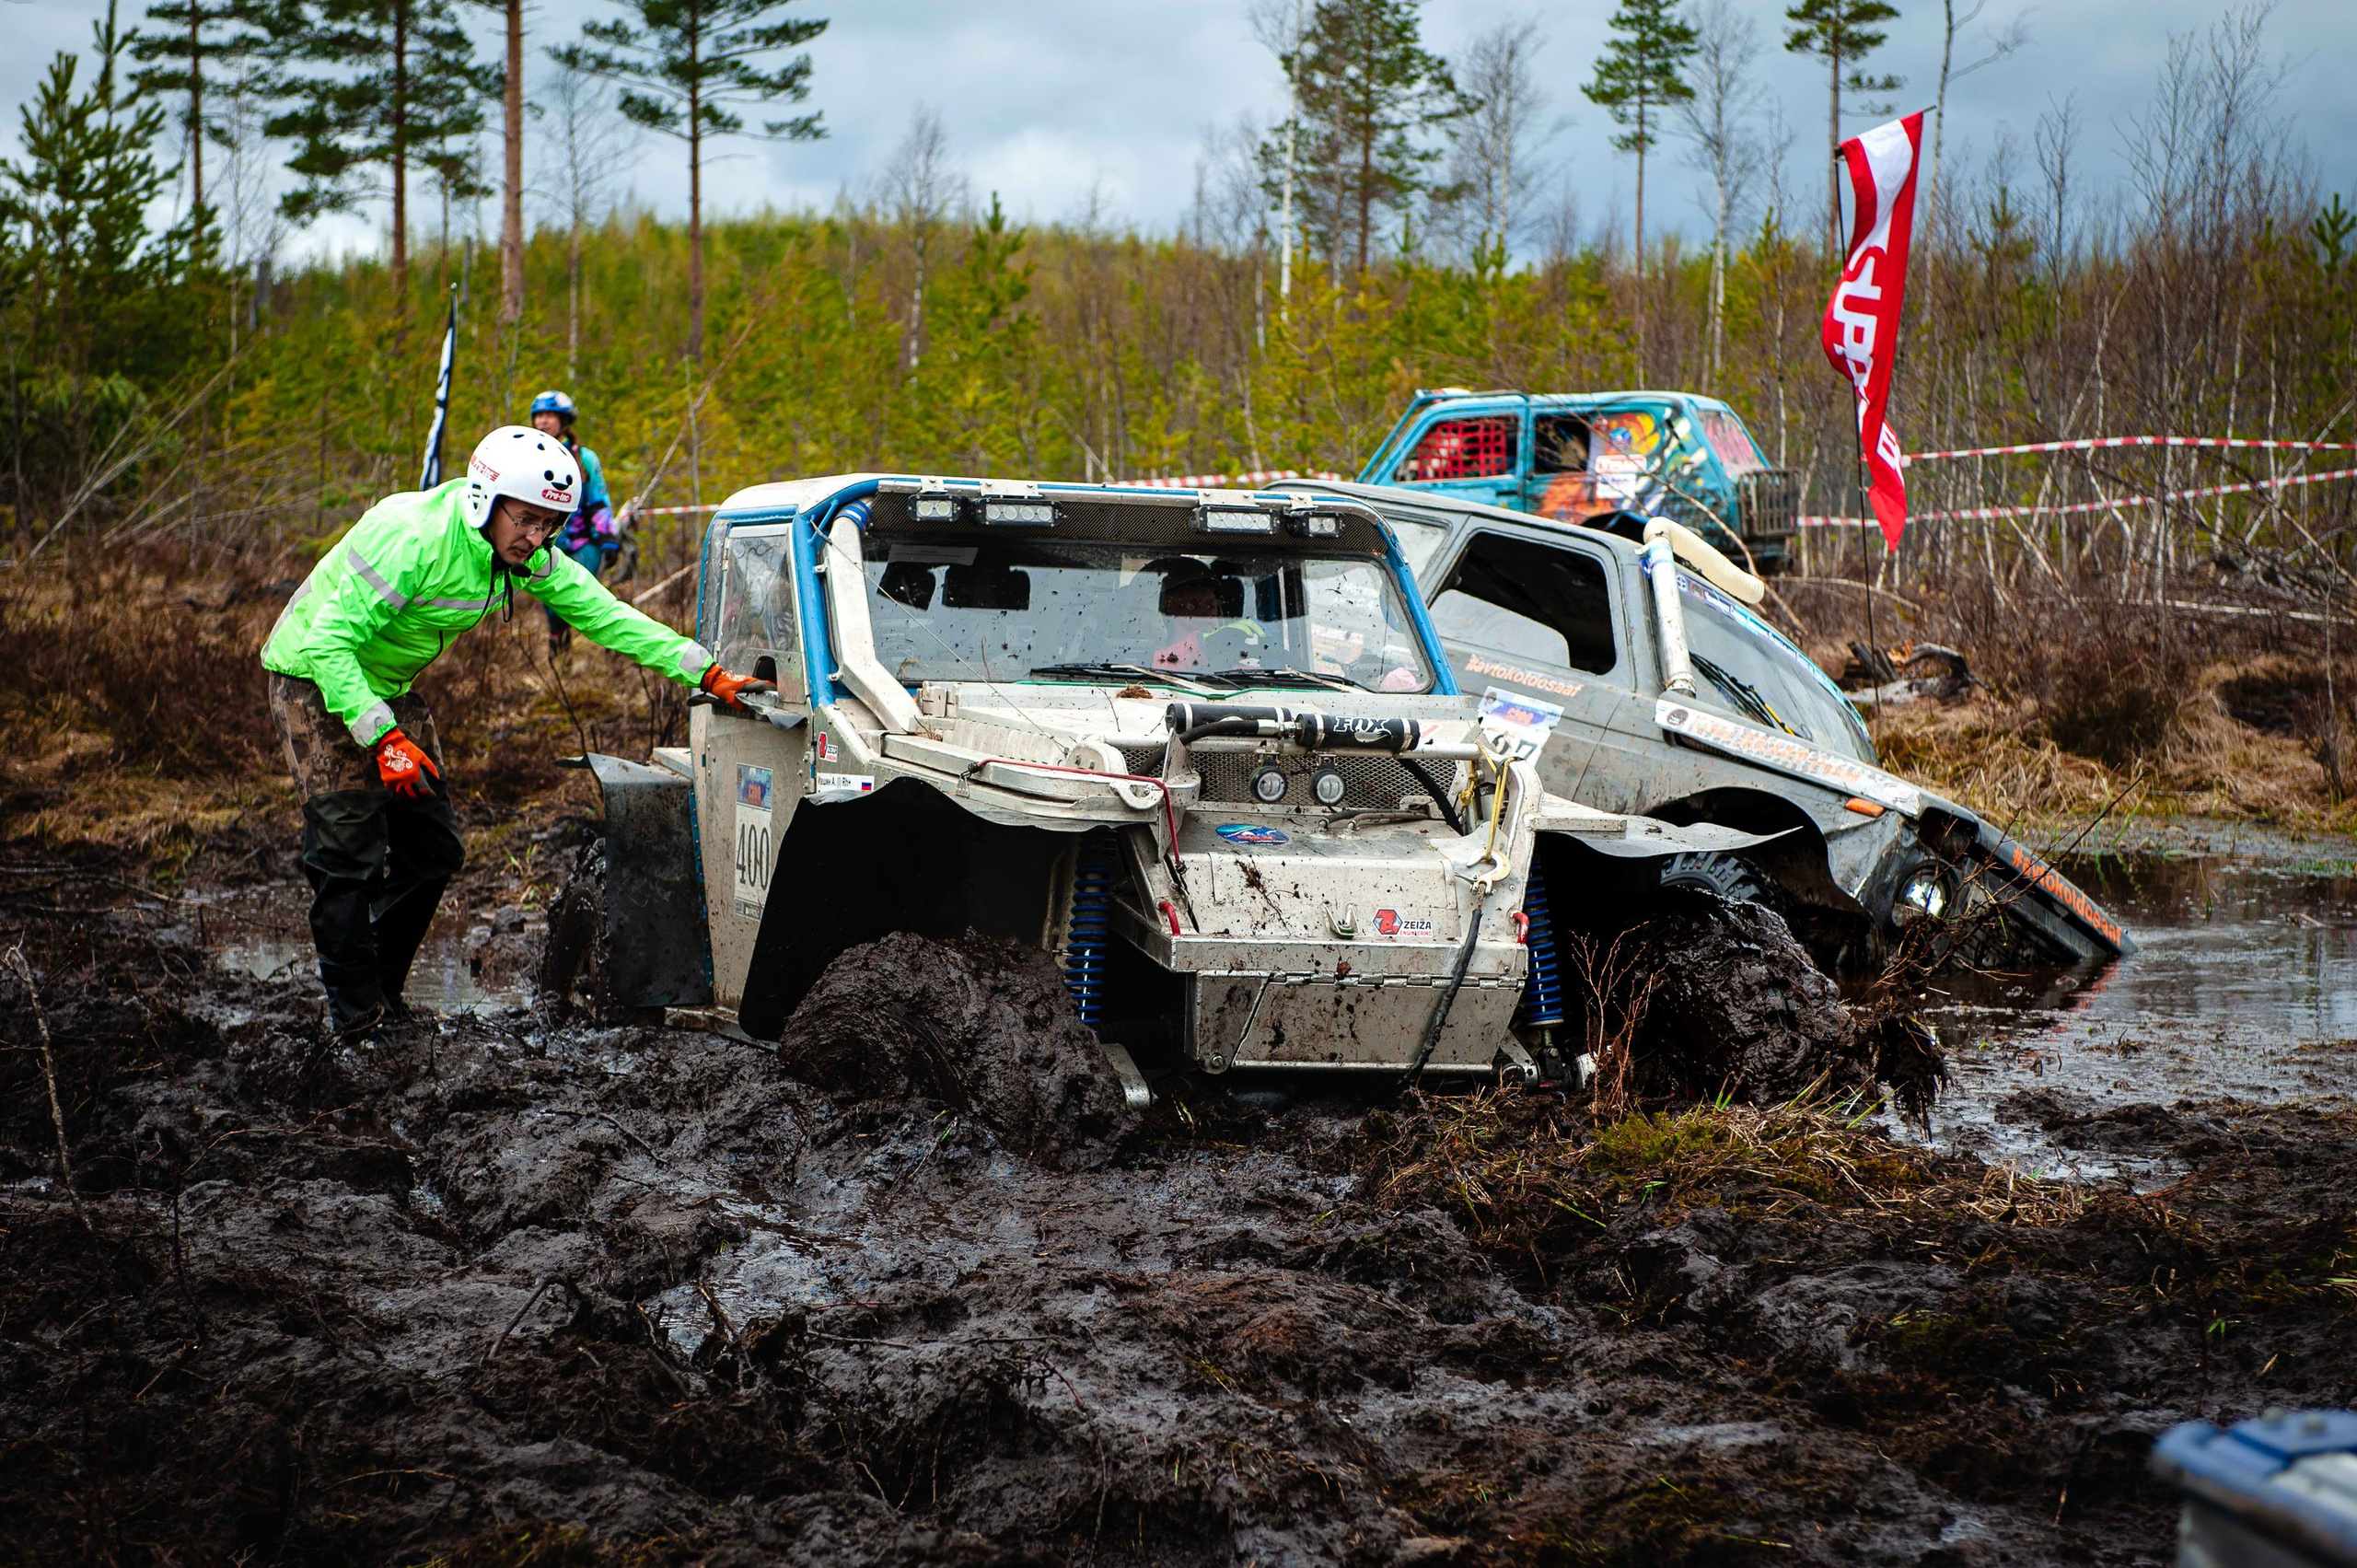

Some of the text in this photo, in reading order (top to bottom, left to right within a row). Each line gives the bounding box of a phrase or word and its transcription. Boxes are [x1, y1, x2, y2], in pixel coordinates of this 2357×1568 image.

[545, 490, 570, 503] Pro-tec
[1466, 653, 1585, 698] #avtokotdosaaf
[1333, 716, 1388, 734] FOX
[736, 823, 770, 891] 400
[1403, 921, 1432, 930] ZEIZA
